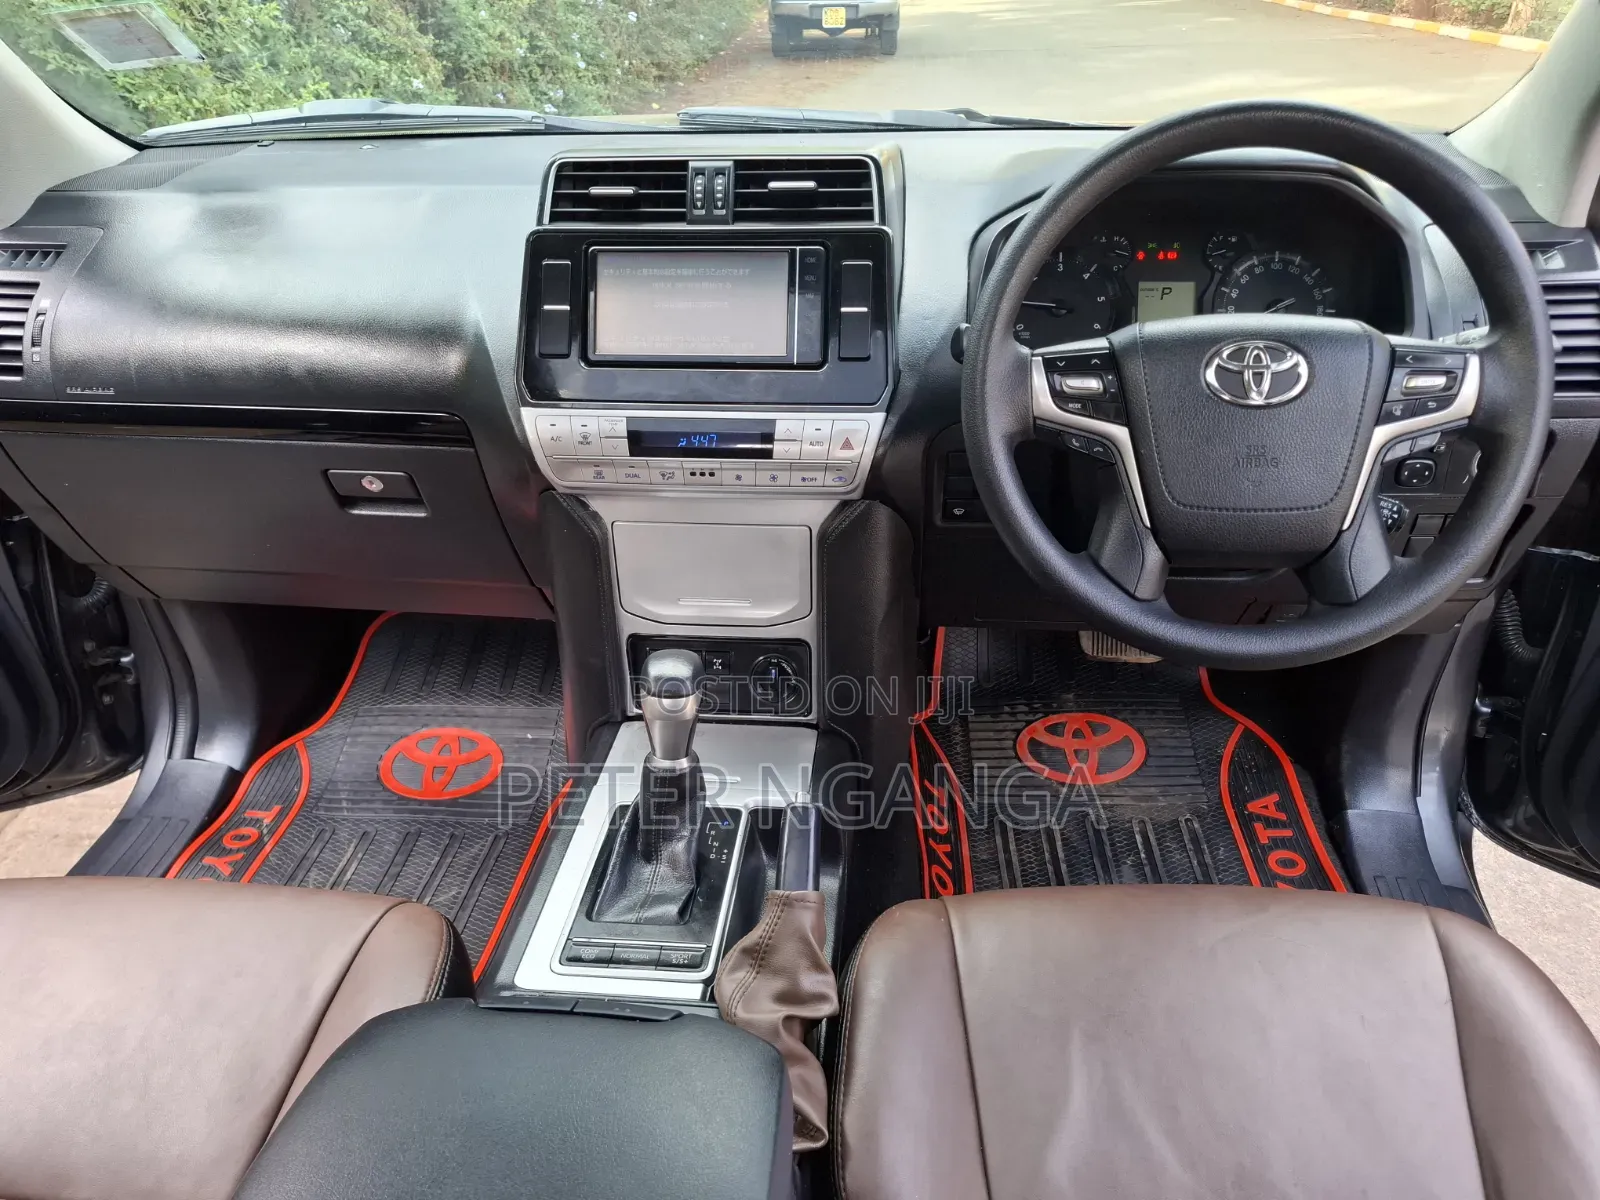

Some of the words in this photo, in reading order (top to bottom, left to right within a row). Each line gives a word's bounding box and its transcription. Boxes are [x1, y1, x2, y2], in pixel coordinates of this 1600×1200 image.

[1057, 263, 1063, 271] 3
[1254, 265, 1264, 274] 80
[1270, 262, 1283, 270] 100
[1288, 265, 1300, 275] 120
[1083, 272, 1090, 280] 4
[1240, 274, 1250, 284] 60
[1302, 274, 1314, 285] 140
[1160, 287, 1172, 300] P
[1230, 288, 1240, 299] 40
[1312, 288, 1322, 300] 160
[1227, 305, 1235, 314] 20
[1245, 444, 1267, 454] SRS
[1233, 457, 1279, 468] AIRBAG
[1380, 500, 1392, 509] RES
[197, 805, 284, 881] TOY
